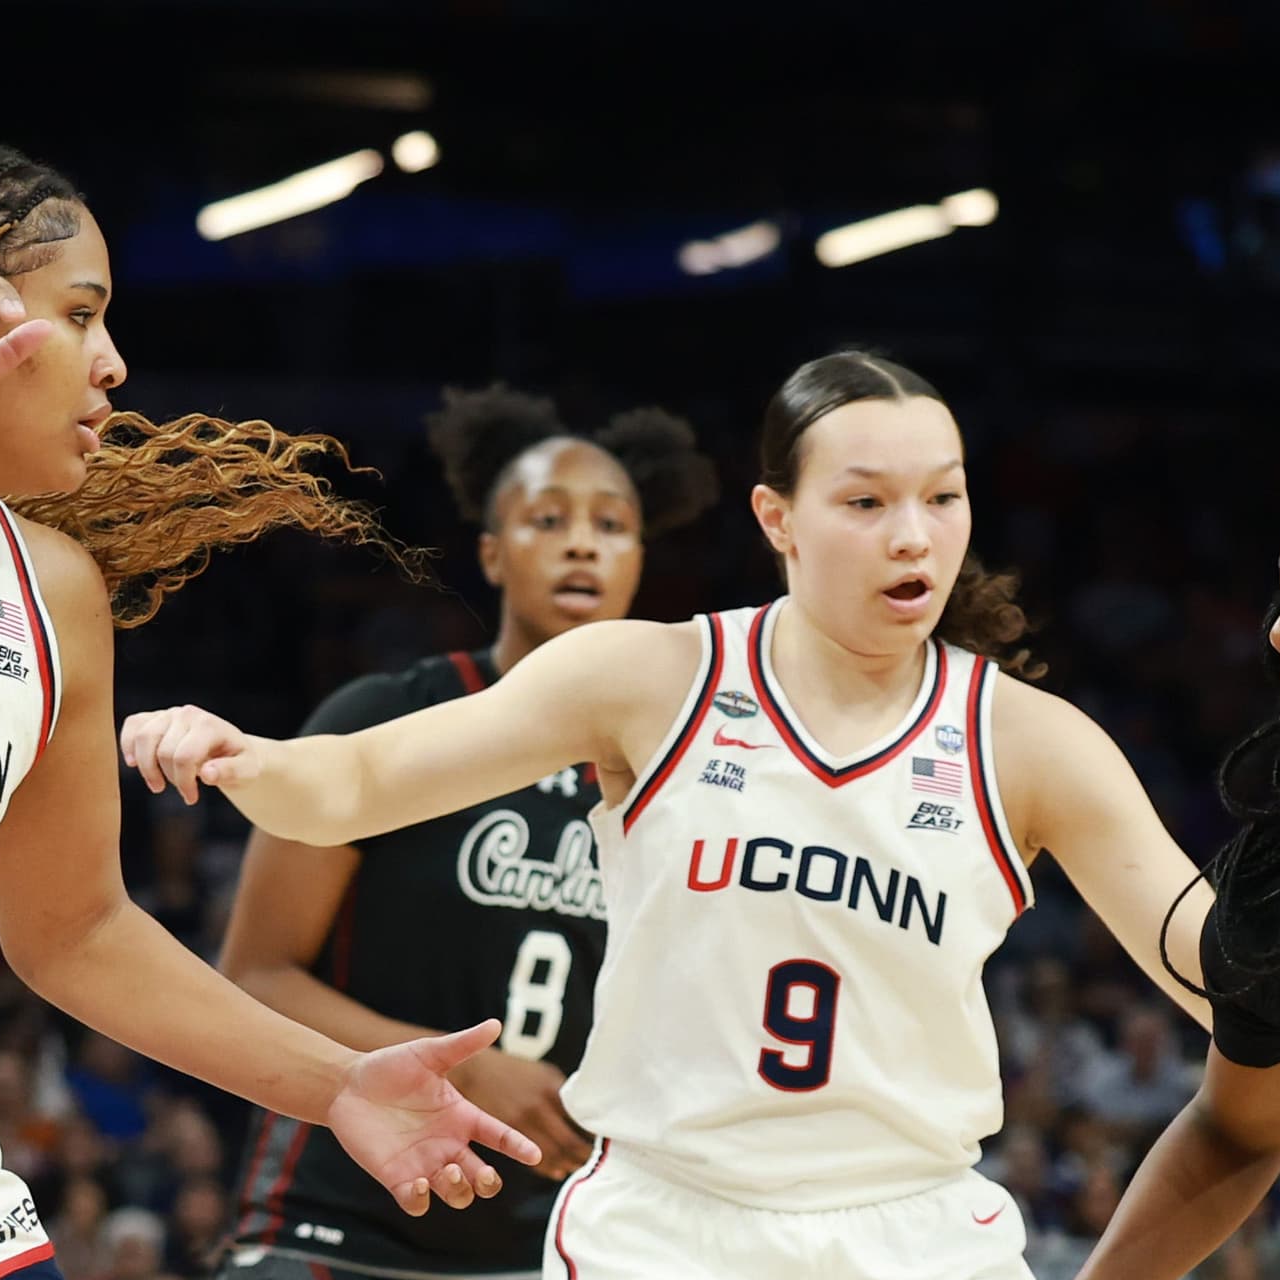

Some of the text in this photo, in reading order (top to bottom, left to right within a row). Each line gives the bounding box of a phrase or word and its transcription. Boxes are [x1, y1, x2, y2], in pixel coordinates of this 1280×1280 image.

[910, 813, 964, 830] EAST
[918, 801, 955, 816] BIG
[457, 809, 608, 921] Carolin
[687, 837, 948, 946] UCONN
[501, 930, 572, 1061] 8
[758, 958, 841, 1093] 9
